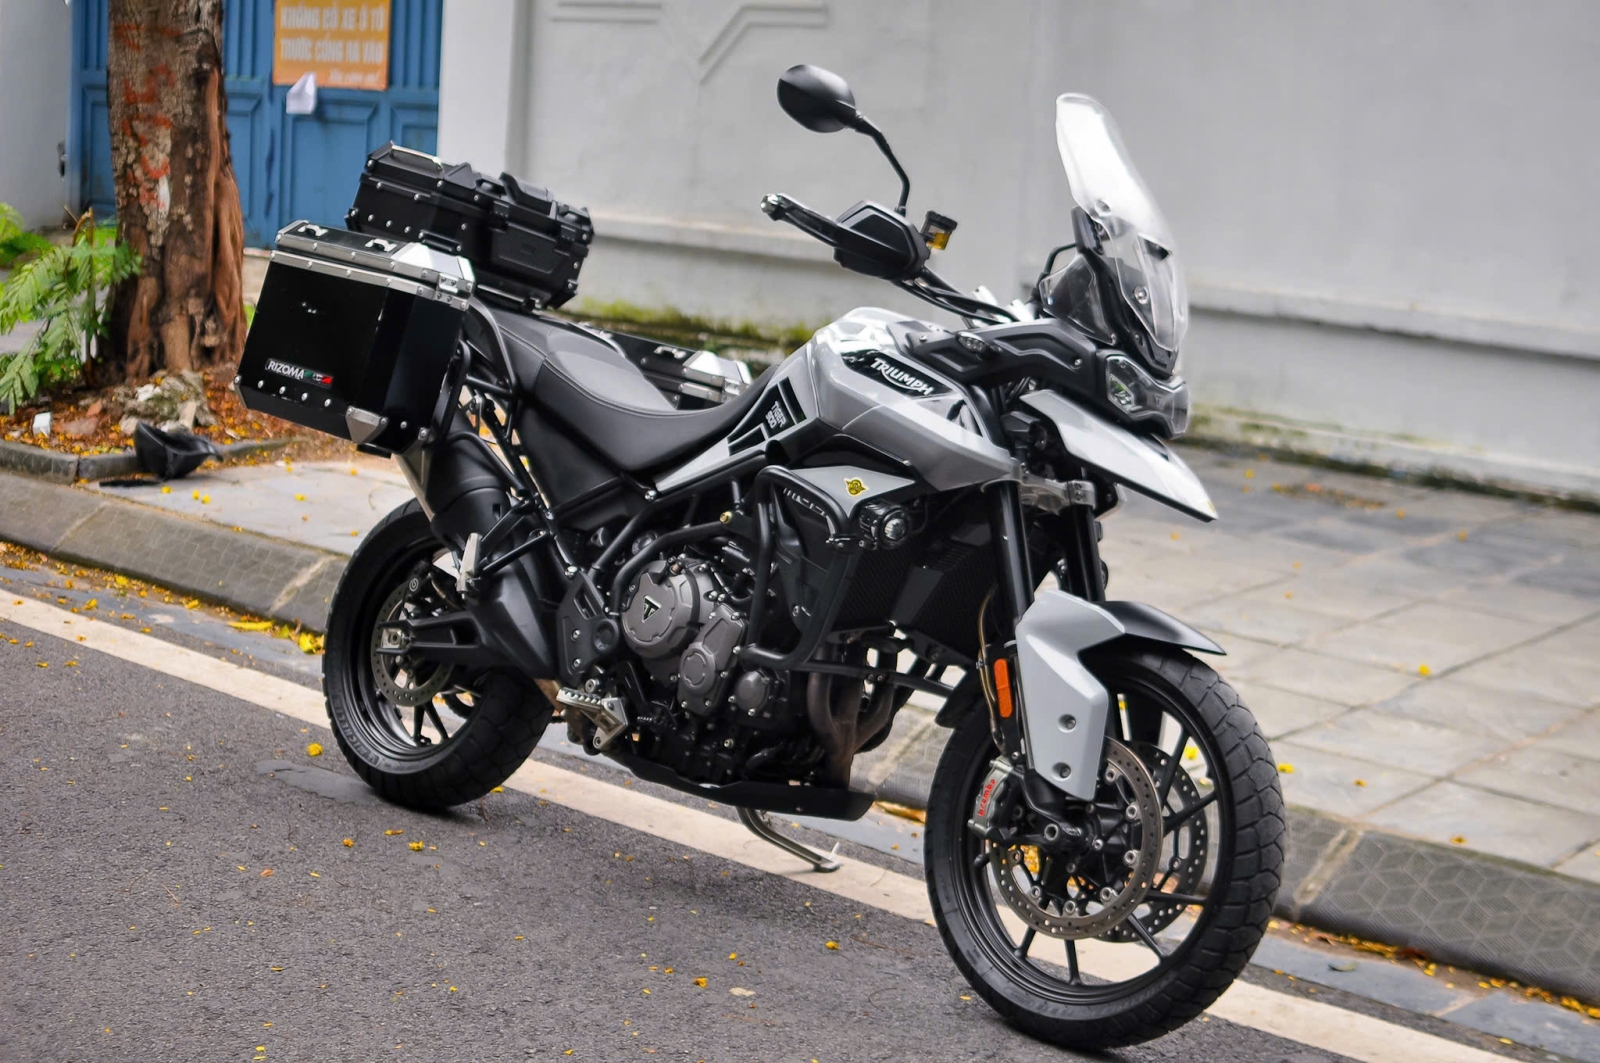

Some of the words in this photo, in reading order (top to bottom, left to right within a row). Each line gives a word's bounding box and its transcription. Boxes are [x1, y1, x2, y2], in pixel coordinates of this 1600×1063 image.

[267, 360, 304, 380] RIZOMA
[870, 357, 934, 396] TRIUMPH
[765, 410, 778, 429] 900
[771, 400, 787, 428] TIGER
